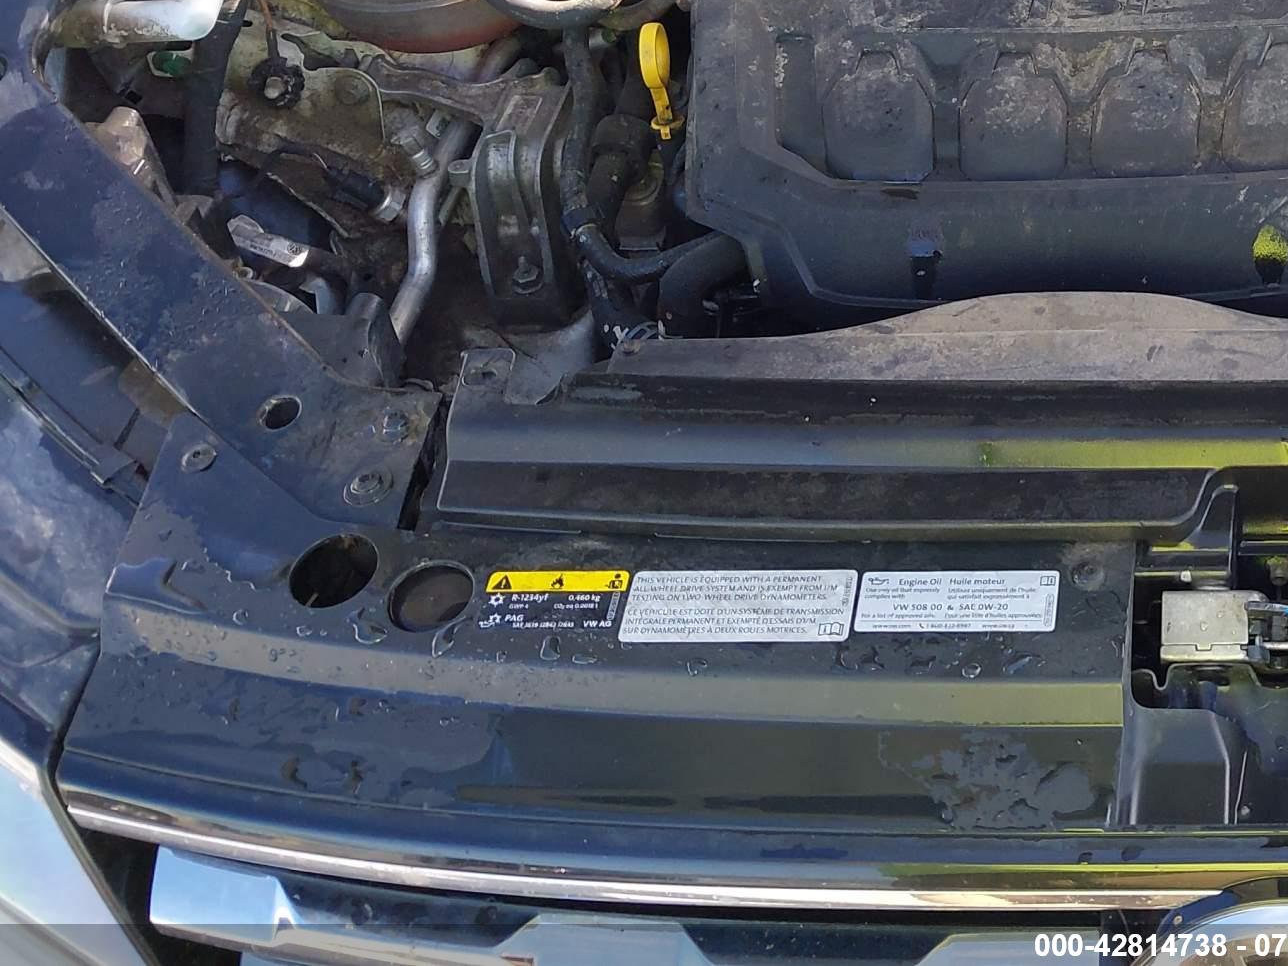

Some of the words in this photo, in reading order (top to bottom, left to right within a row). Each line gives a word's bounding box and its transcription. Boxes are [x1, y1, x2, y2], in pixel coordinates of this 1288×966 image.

[899, 578, 928, 587] Engine
[511, 593, 550, 602] R-1234yf
[893, 603, 909, 611] VW
[911, 603, 928, 611] 508
[930, 603, 943, 611] 00
[947, 603, 954, 611] &
[959, 603, 975, 611] SAE
[978, 603, 1009, 611] 0W-20
[583, 620, 598, 628] VW
[599, 620, 613, 628] AG
